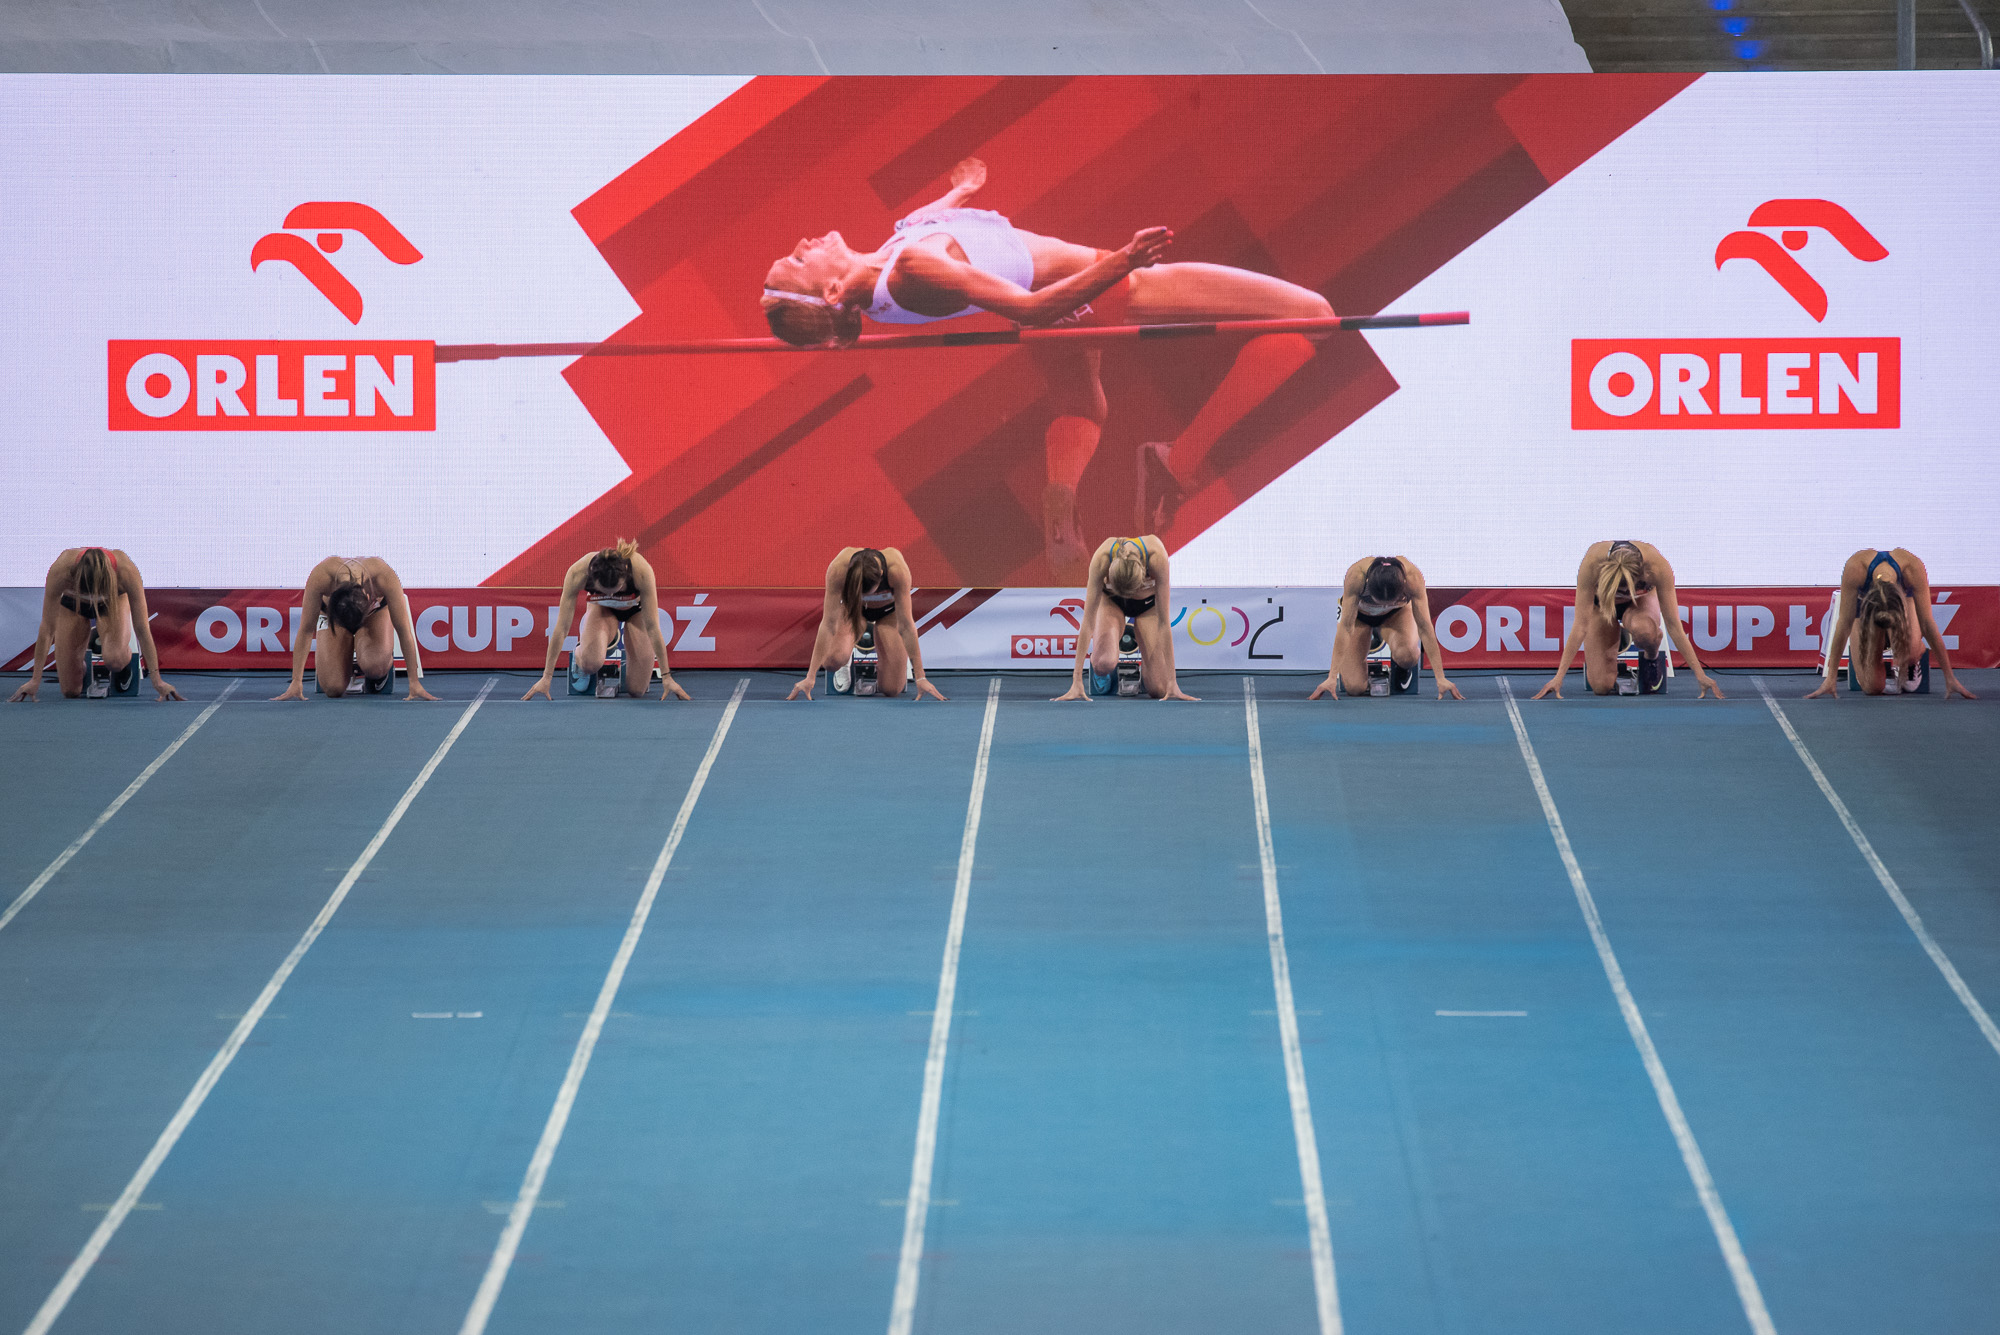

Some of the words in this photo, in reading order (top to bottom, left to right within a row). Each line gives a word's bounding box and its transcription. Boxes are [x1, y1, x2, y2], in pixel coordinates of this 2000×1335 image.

[126, 353, 414, 418] ORLEN
[1588, 351, 1878, 417] ORLEN
[195, 605, 317, 653] ORL
[415, 605, 535, 653] CUP
[1015, 638, 1094, 656] ORLE
[1434, 604, 1585, 653] ORL
